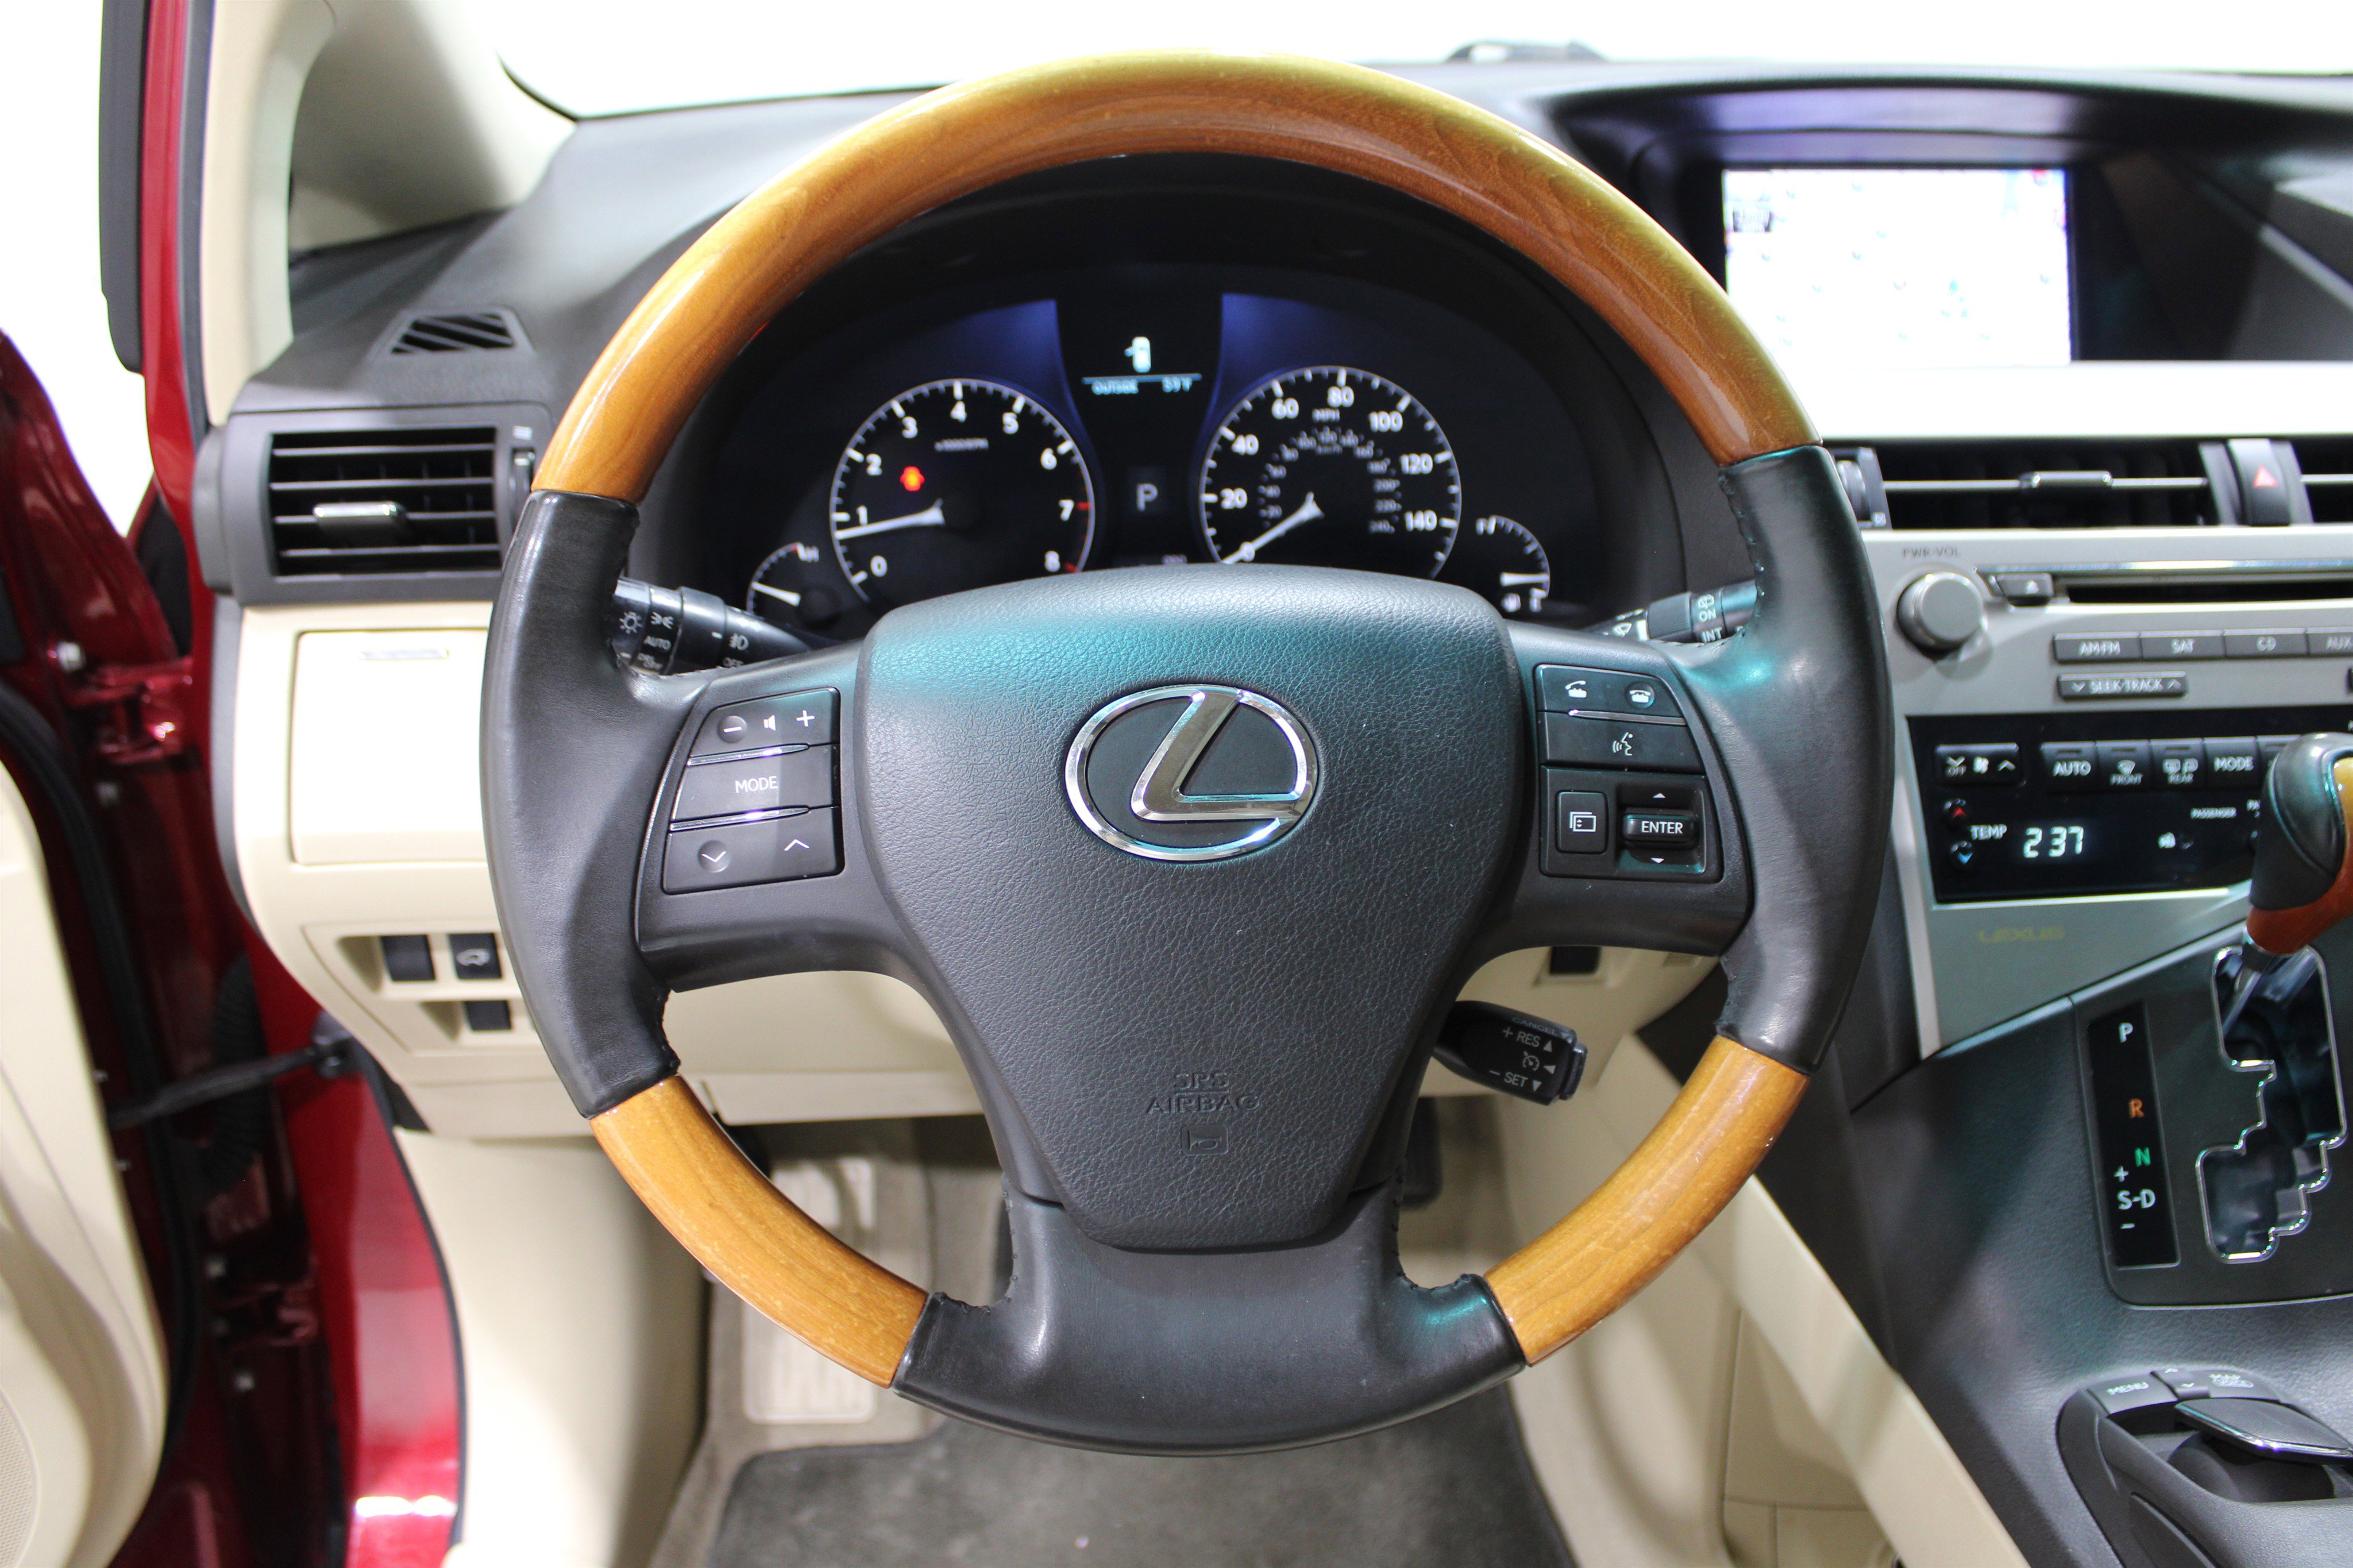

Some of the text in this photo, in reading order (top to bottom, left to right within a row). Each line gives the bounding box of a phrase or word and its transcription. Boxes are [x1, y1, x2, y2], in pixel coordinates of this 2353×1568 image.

[1328, 386, 1354, 408] 80
[950, 401, 967, 422] 4
[1271, 397, 1299, 419] 60
[901, 416, 918, 439] 3
[1002, 412, 1019, 434] 5
[1368, 410, 1403, 432] 100
[1232, 434, 1259, 455] 40
[866, 454, 882, 476] 2
[1040, 447, 1057, 470] 6
[1400, 453, 1433, 474] 120
[1136, 483, 1158, 511] P
[1221, 488, 1247, 509] 20
[1059, 499, 1074, 521] 7
[1404, 510, 1437, 531] 140
[870, 555, 888, 577] 0
[1044, 550, 1060, 572] 8
[1699, 609, 1717, 622] ON
[643, 635, 672, 651] AUTO
[1701, 627, 1723, 643] INT
[2256, 636, 2276, 651] CD
[2171, 639, 2194, 654] SAT
[2053, 760, 2091, 776] AUTO
[2214, 756, 2254, 772] MODE
[735, 775, 779, 794] MODE
[1641, 821, 1683, 835] ENTER
[1970, 824, 2007, 840] TEMP
[1511, 1016, 1558, 1036] CANCEL
[2118, 1022, 2134, 1043] P
[1516, 1031, 1541, 1048] RES
[1504, 1071, 1528, 1087] SET
[1146, 1094, 1261, 1114] AIRBAG
[2128, 1098, 2145, 1119] R
[2134, 1147, 2151, 1167] N
